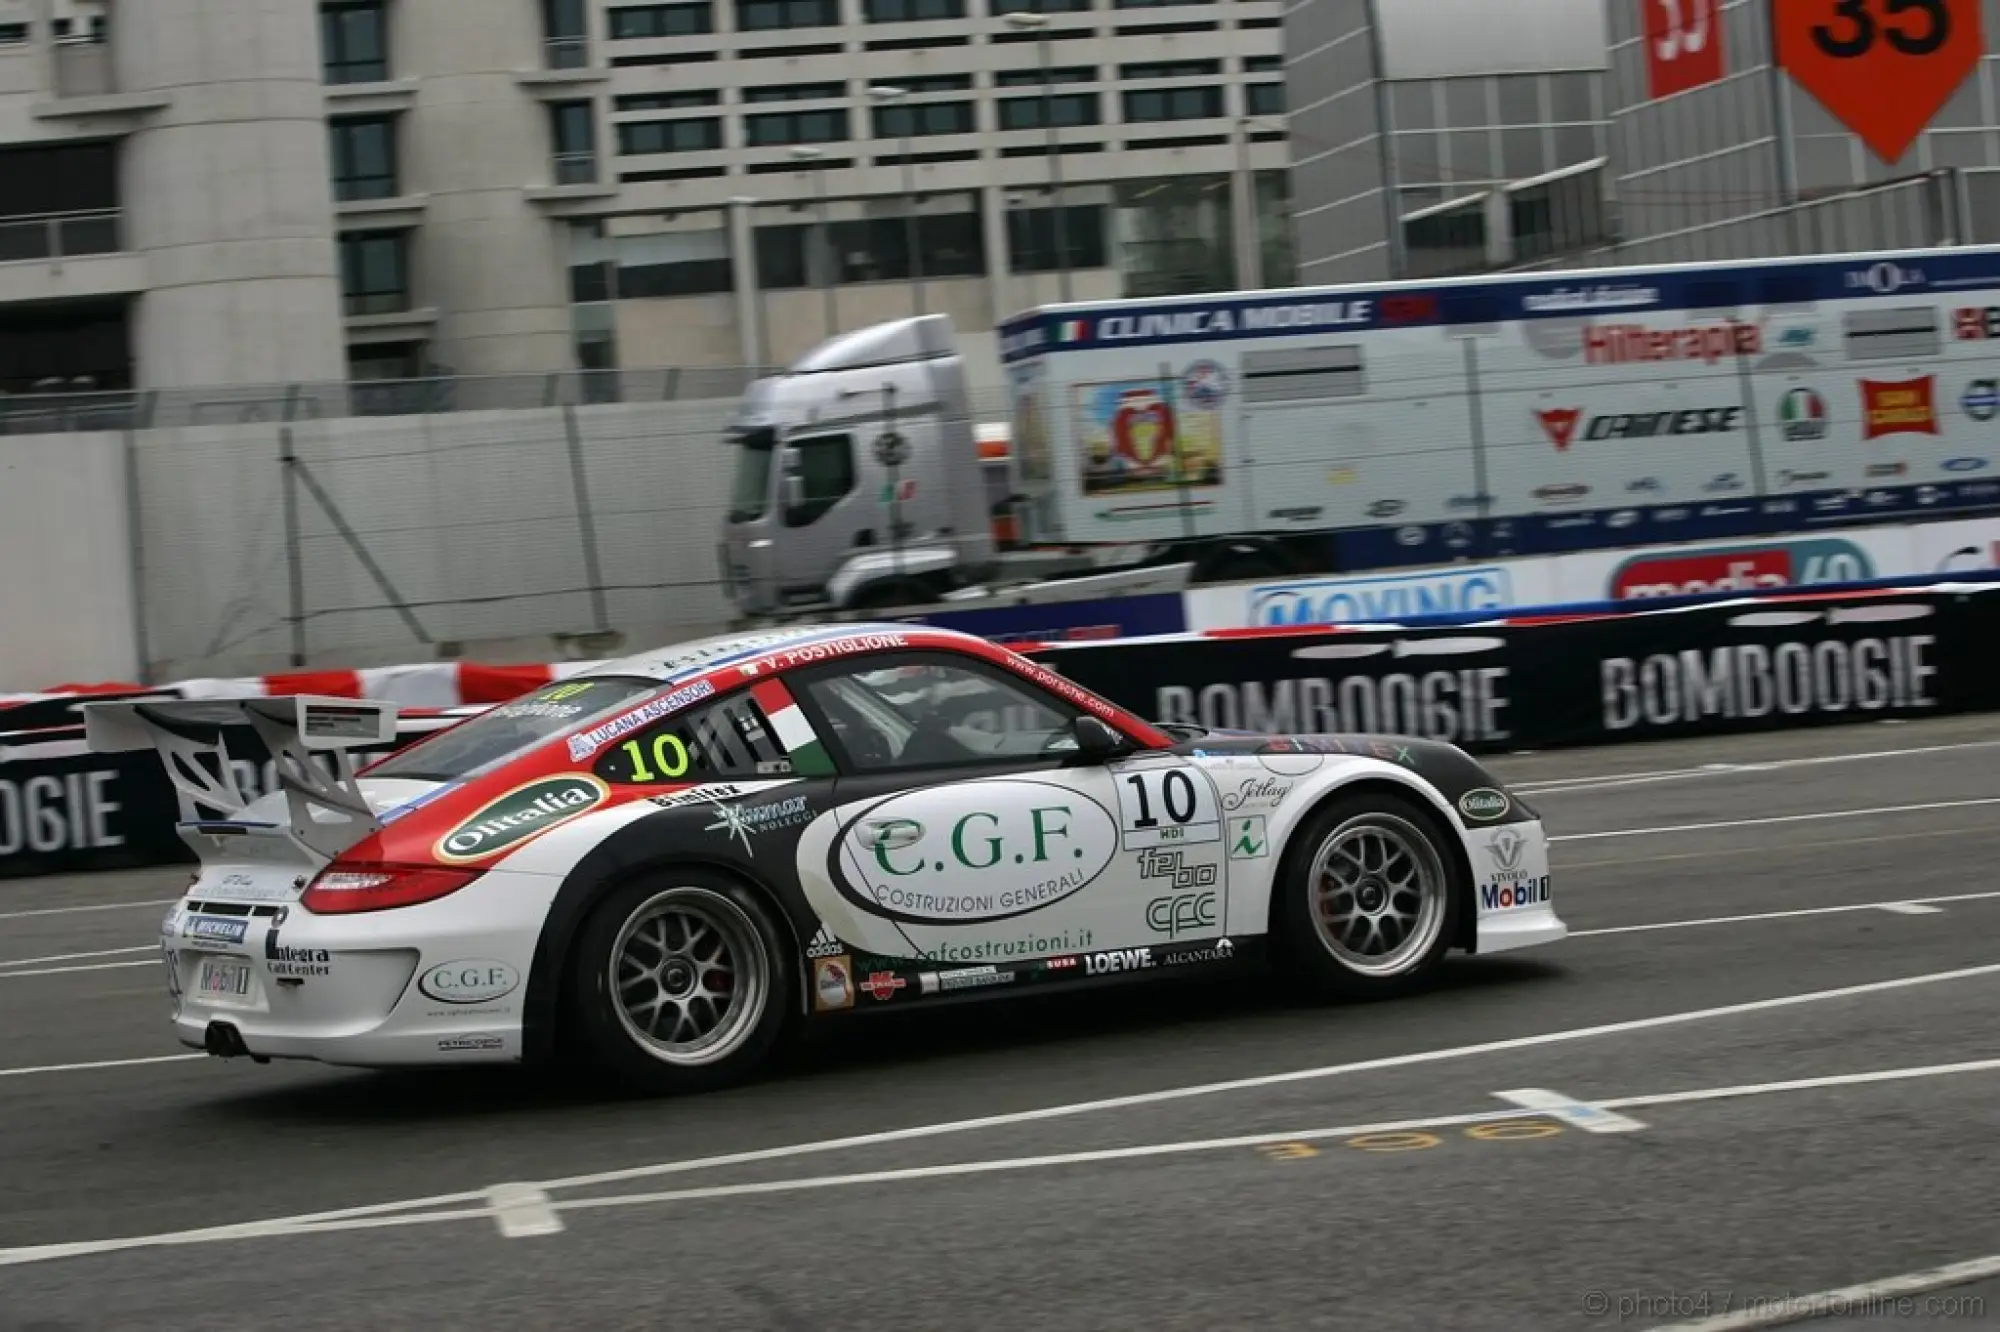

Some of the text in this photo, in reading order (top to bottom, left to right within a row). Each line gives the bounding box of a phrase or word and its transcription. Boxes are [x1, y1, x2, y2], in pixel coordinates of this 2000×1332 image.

[1812, 0, 1948, 58] 35
[1097, 310, 1237, 340] CLINICA
[1239, 300, 1372, 330] MOBILE
[789, 634, 909, 665] POSTIGLIONE
[1158, 667, 1511, 742] BOMBOOGIE
[1601, 635, 1937, 730] BOMBOOGIE
[589, 712, 644, 744] LUCANA
[621, 734, 689, 782] 10
[448, 787, 595, 851] Olitalia
[1127, 769, 1196, 828] 10
[873, 805, 1083, 876] C.G.F.
[876, 868, 1084, 913] COSTRUZIONI GENERALI
[1481, 878, 1538, 909] Mobil
[434, 967, 507, 989] C.G.F.
